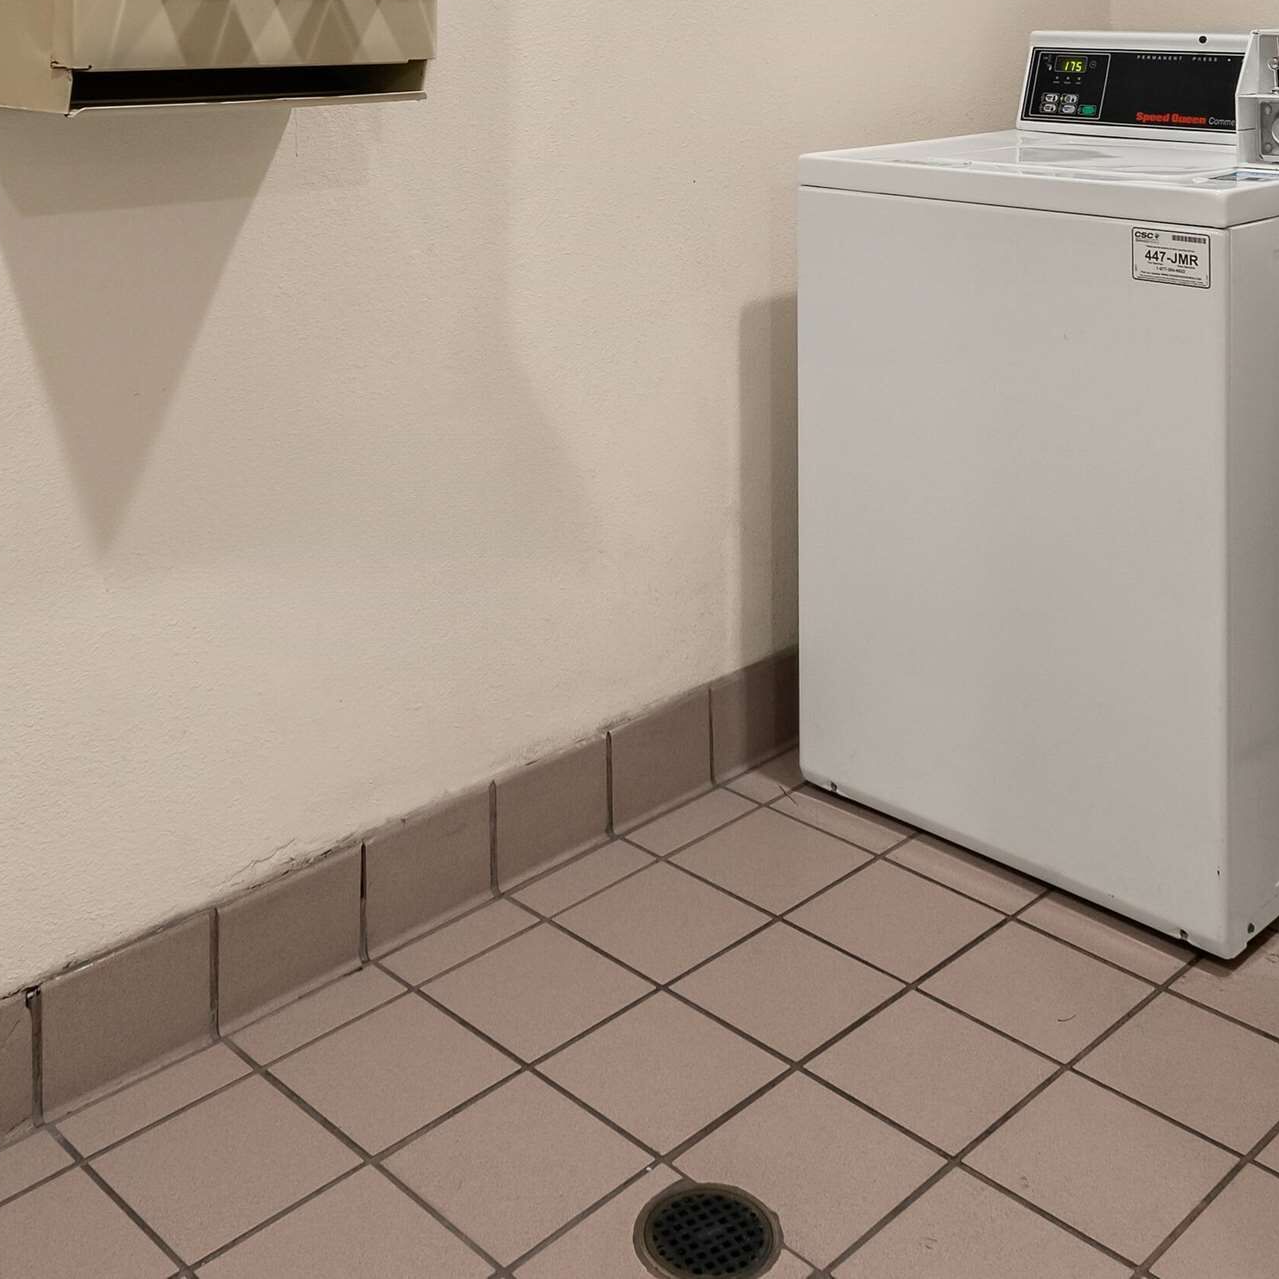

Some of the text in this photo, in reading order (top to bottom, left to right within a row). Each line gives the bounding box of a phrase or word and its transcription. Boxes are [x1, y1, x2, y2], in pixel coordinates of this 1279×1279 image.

[1064, 60, 1082, 72] 175
[1135, 111, 1171, 124] Speed
[1171, 113, 1206, 125] Queen
[1134, 231, 1154, 239] CSC
[1144, 249, 1199, 267] 447-JMR
